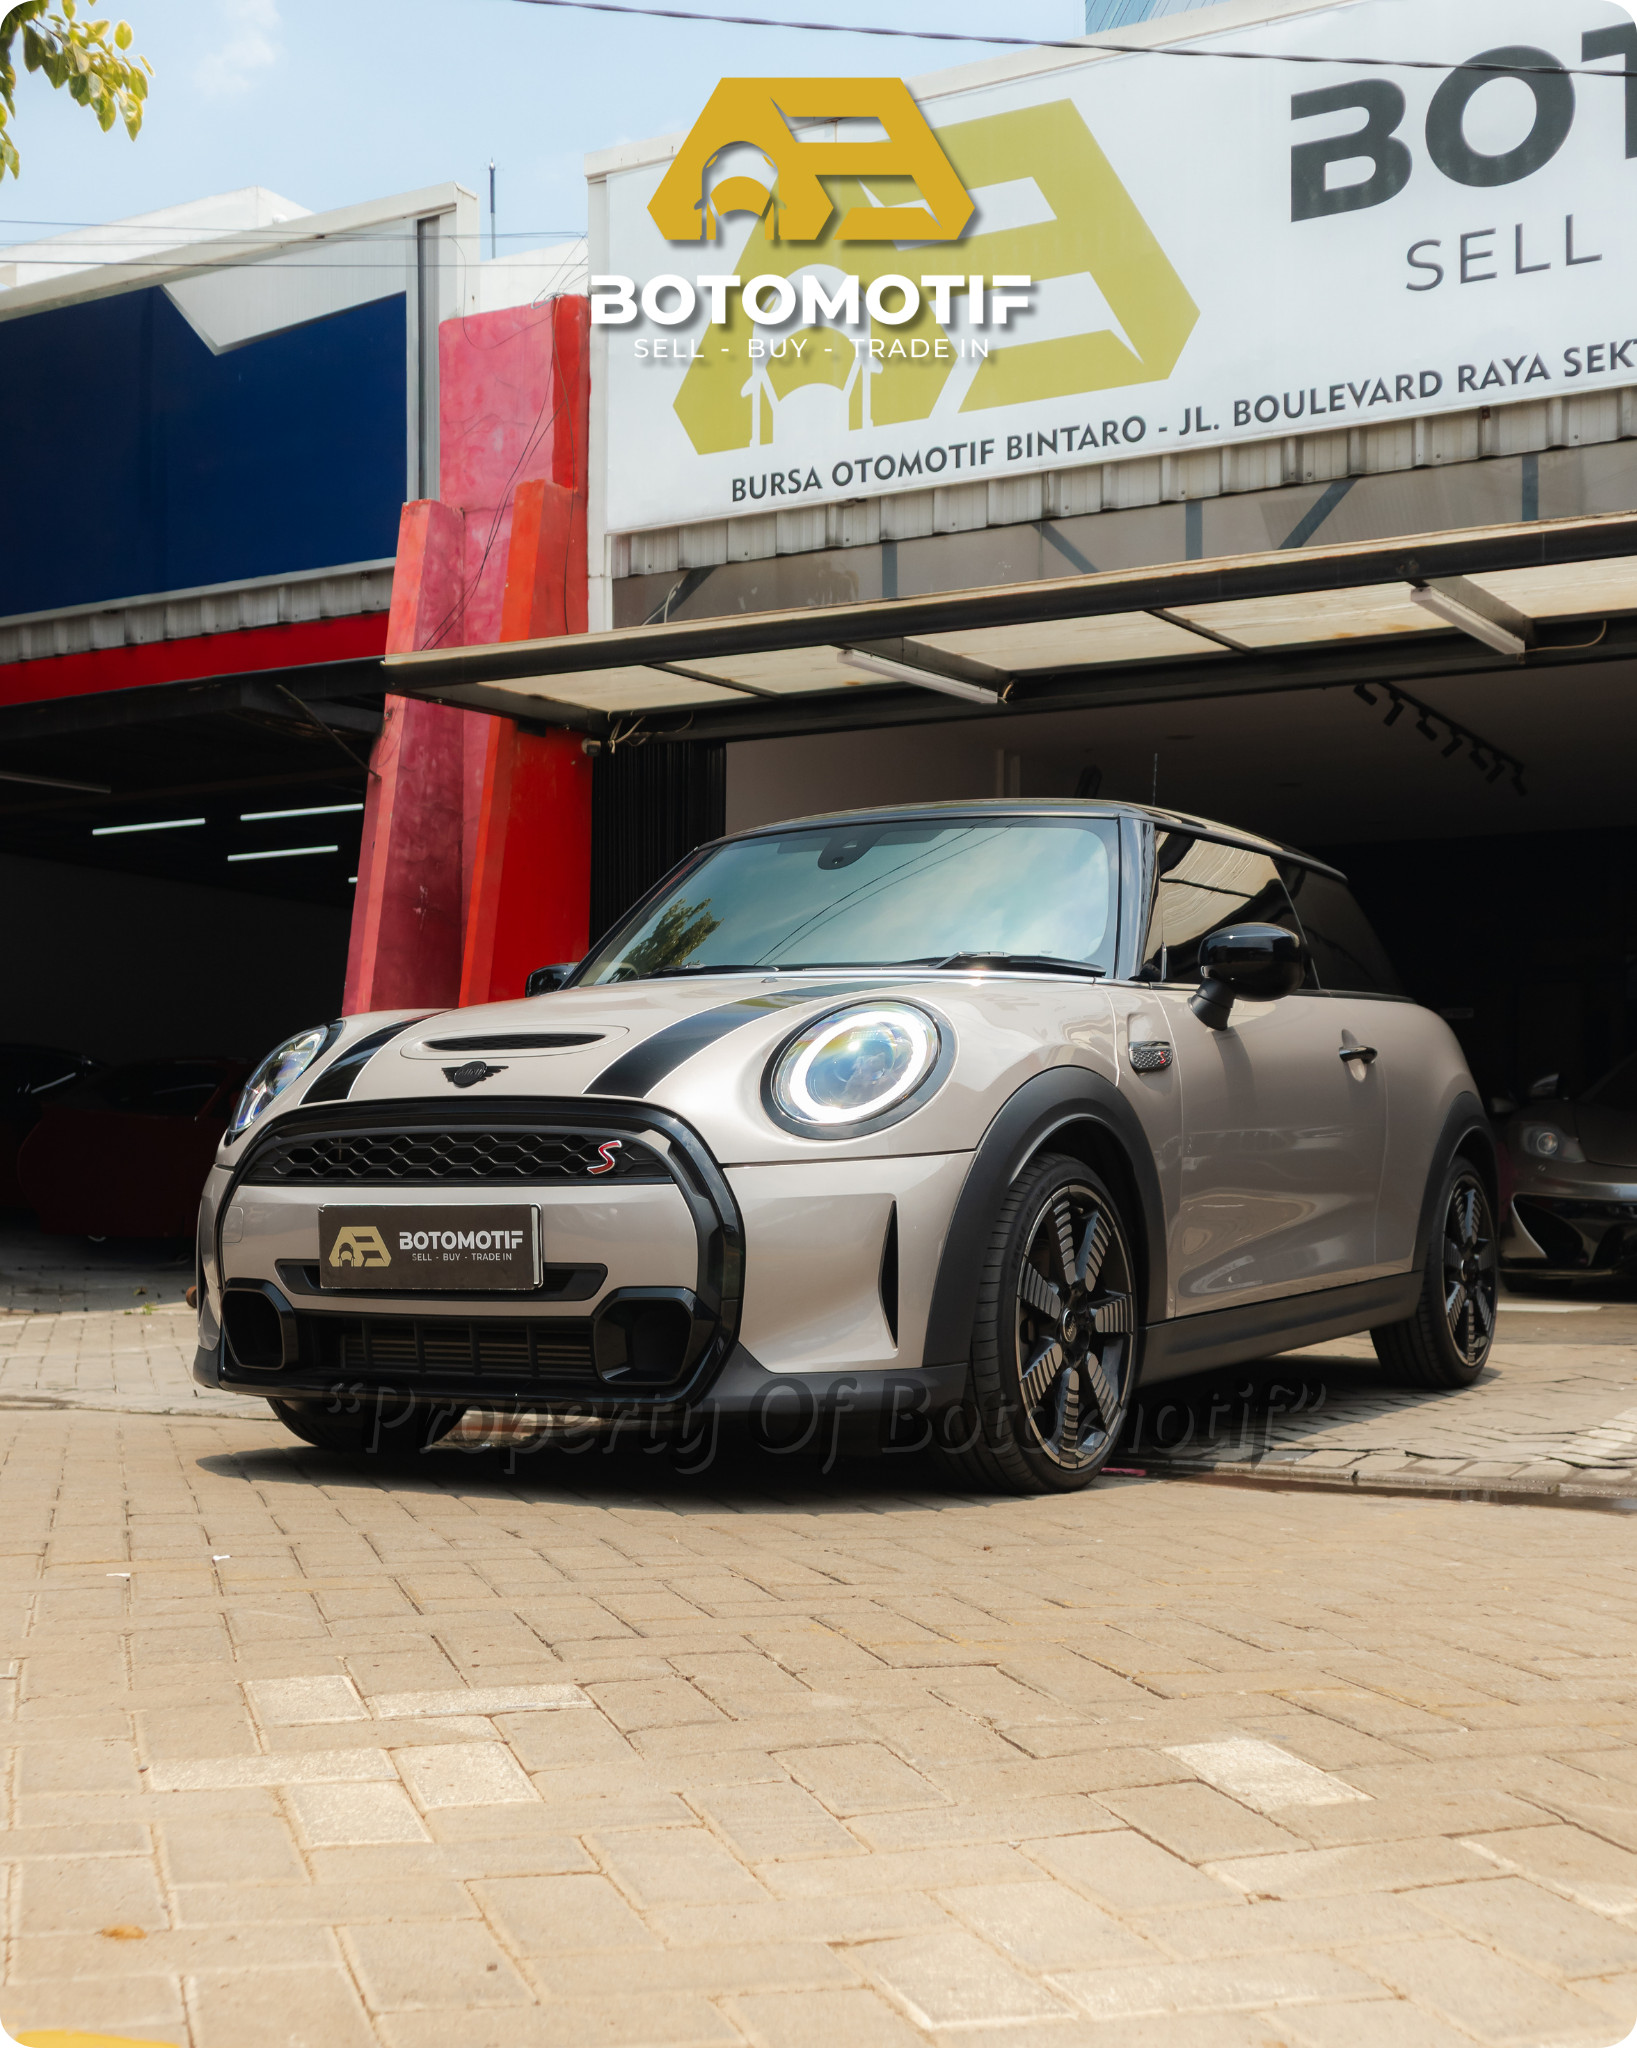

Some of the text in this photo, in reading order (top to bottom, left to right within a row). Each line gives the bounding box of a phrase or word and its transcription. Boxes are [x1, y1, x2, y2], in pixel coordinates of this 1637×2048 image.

[1406, 214, 1602, 291] SELL
[732, 466, 823, 502] BURSA
[832, 439, 994, 487] OTOMOTIF
[1006, 415, 1146, 461] BINTARO
[1179, 406, 1219, 436] JL.
[1234, 370, 1443, 426] BOULEVARD
[1458, 352, 1551, 393] RAYA
[587, 1139, 622, 1175] S
[399, 1230, 524, 1250] BOTOMOTIF
[412, 1252, 432, 1262] SELL
[443, 1252, 460, 1261] BUY
[471, 1252, 501, 1261] TRADE
[503, 1252, 512, 1261] IN
